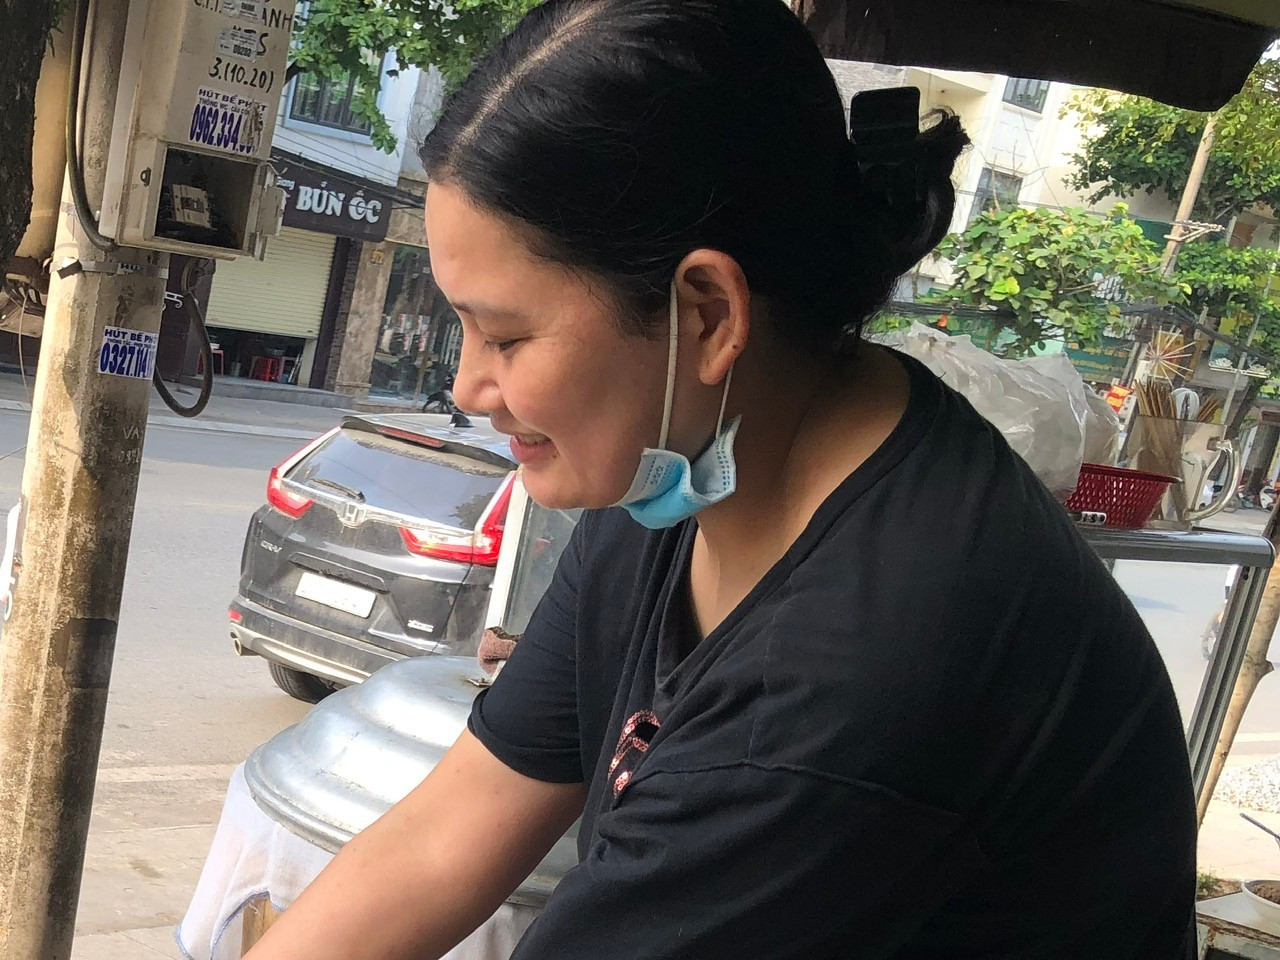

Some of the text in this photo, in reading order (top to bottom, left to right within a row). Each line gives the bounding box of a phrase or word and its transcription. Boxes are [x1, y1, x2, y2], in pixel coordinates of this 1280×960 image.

[199, 88, 221, 99] HÚT
[238, 98, 267, 111] PHT
[105, 328, 128, 339] HÚT
